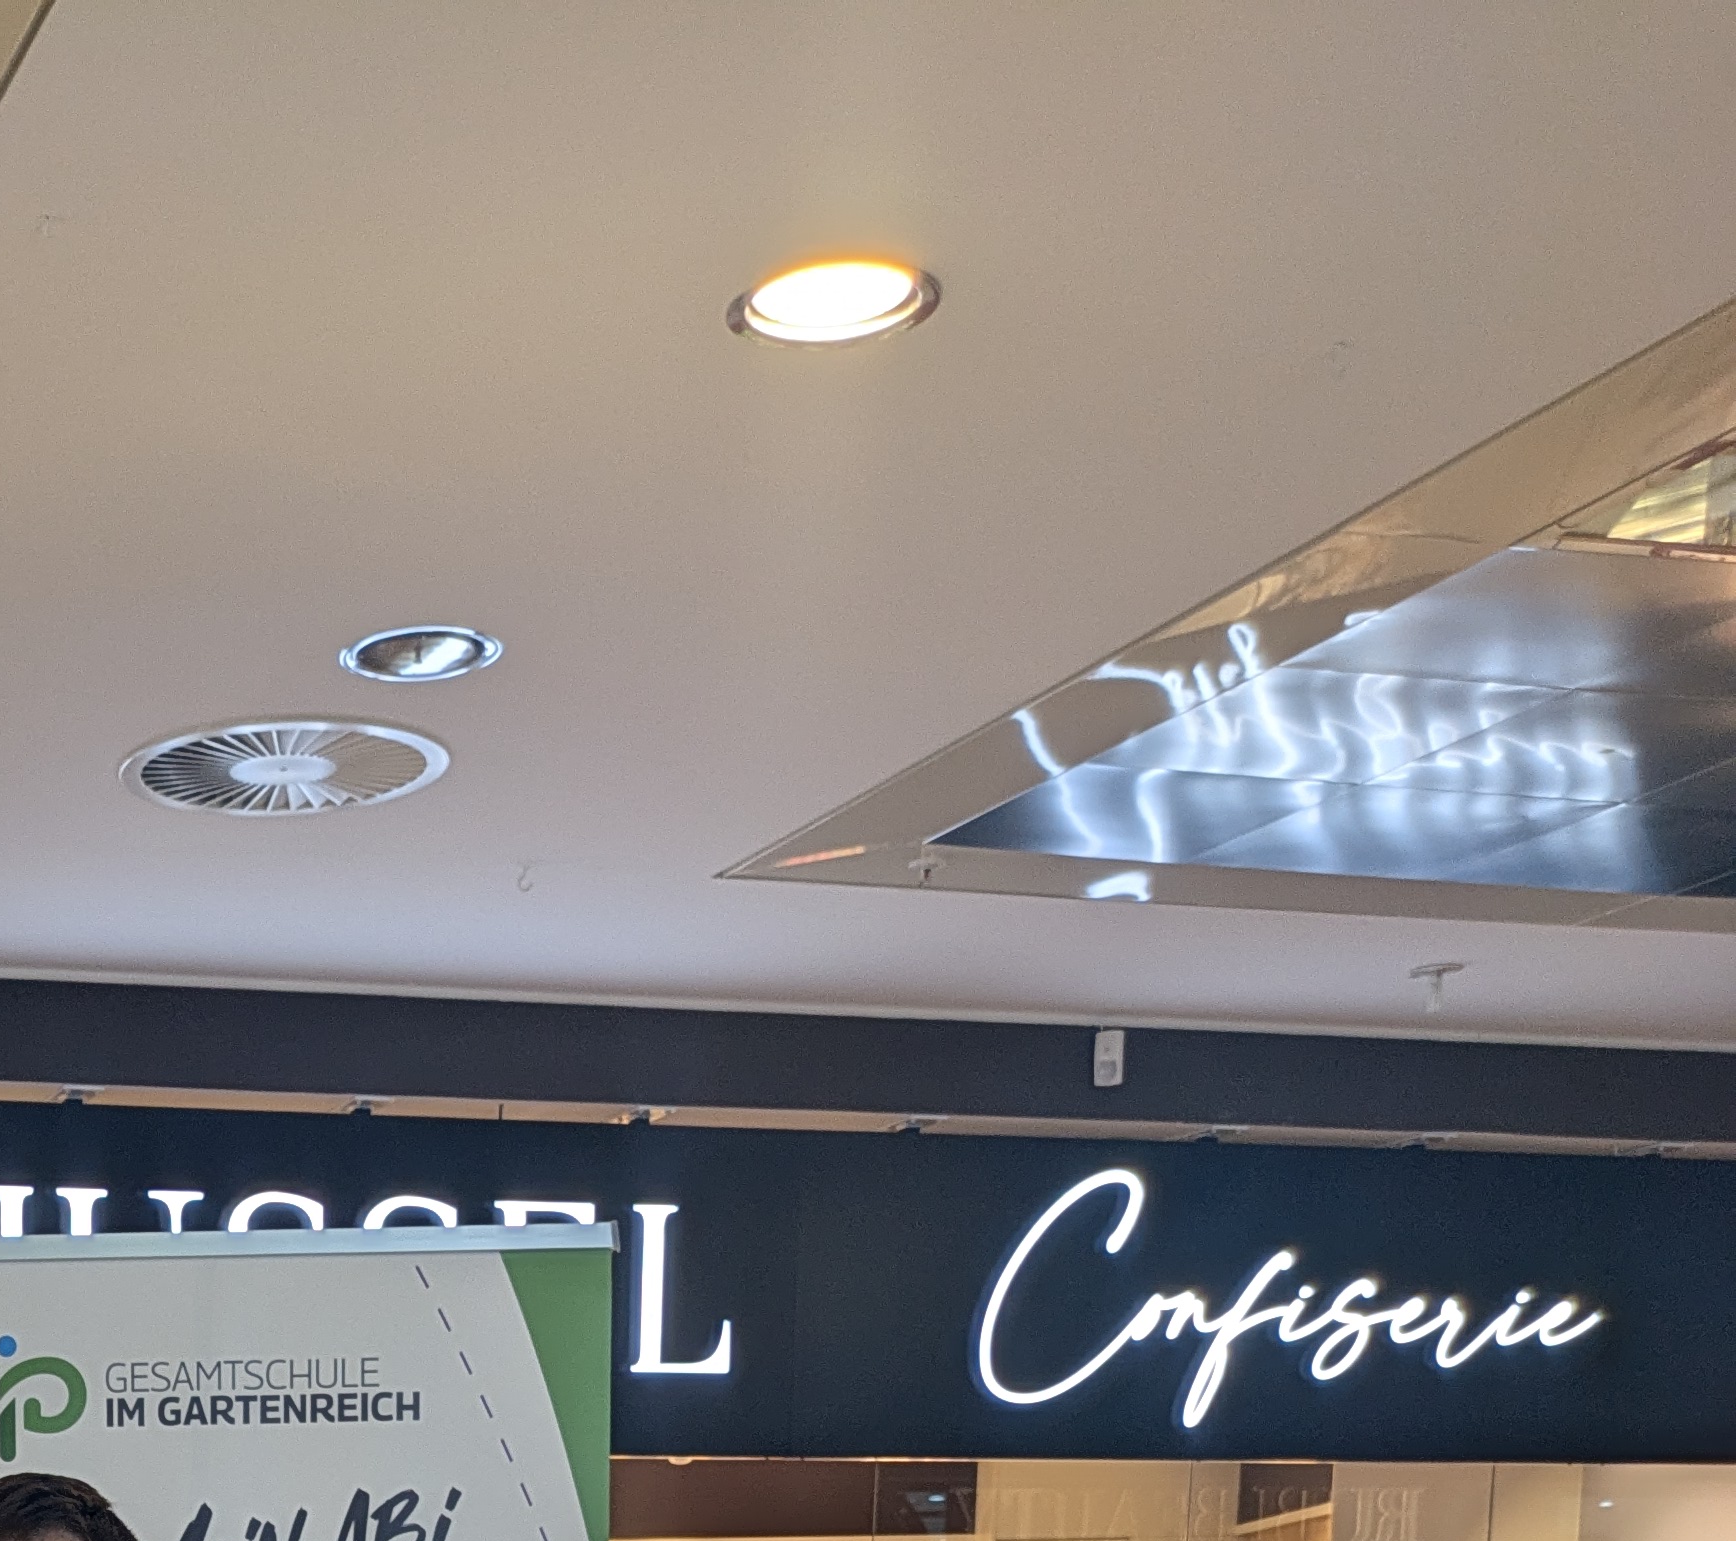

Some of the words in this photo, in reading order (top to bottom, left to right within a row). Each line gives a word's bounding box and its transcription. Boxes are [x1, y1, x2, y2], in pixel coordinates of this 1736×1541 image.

[980, 1167, 1606, 1428] Confiserie
[104, 1356, 380, 1391] GESAMTSCHULE
[105, 1397, 145, 1428] IM
[157, 1391, 421, 1427] GARTENREICH
